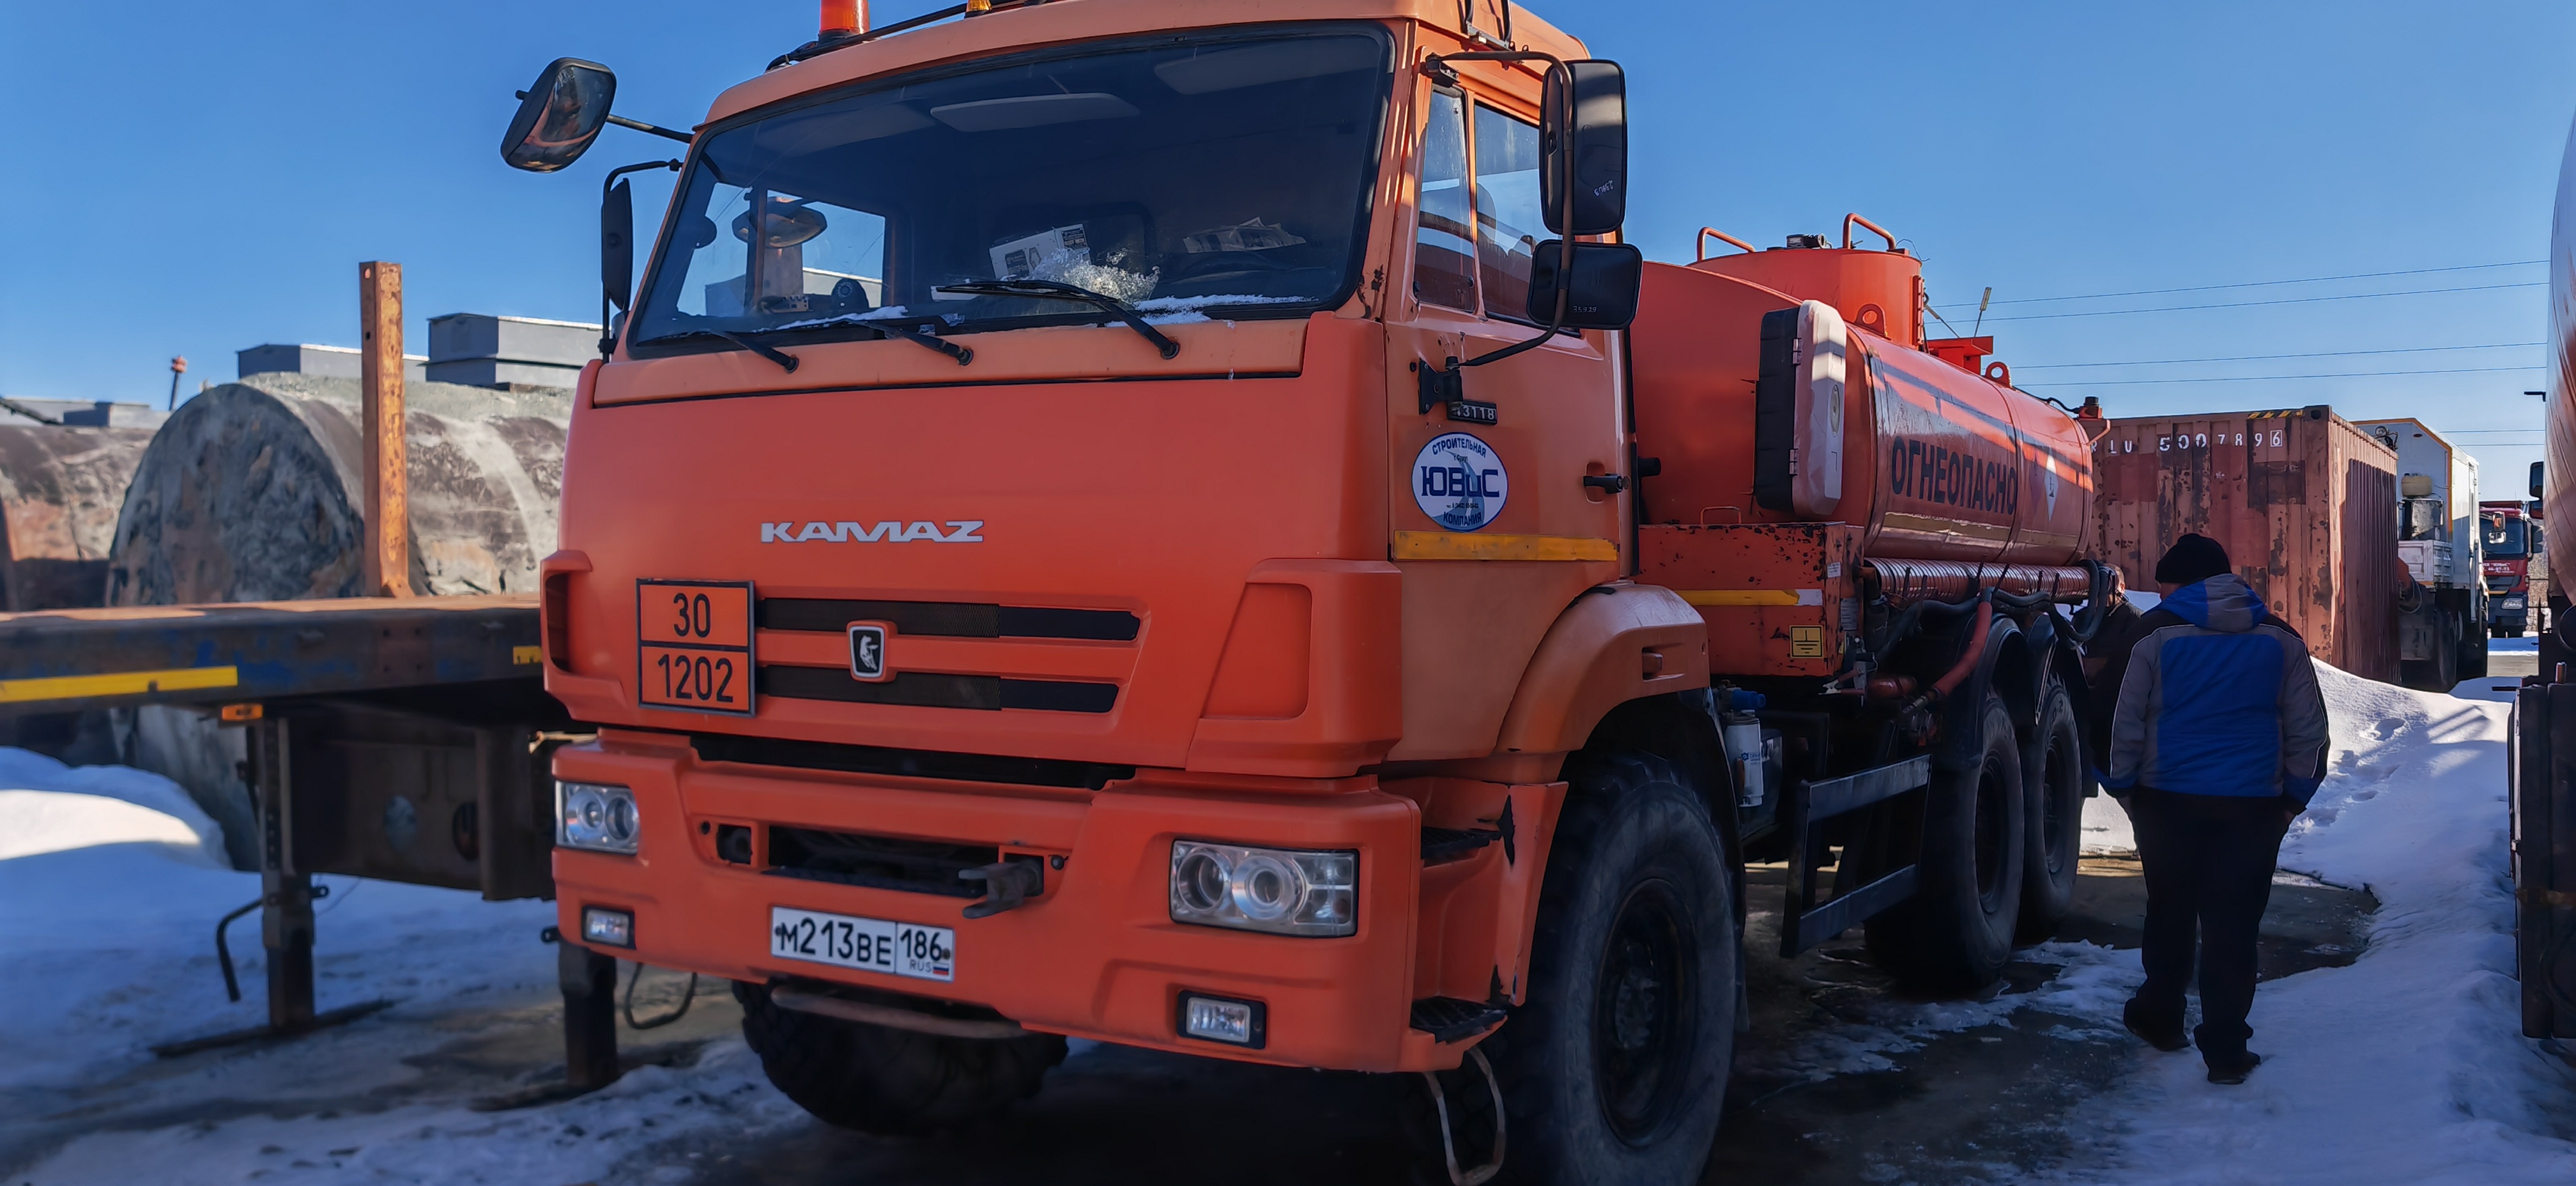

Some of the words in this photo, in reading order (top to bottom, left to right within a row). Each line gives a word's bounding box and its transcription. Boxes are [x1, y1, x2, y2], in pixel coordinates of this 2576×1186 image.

[1432, 437, 1487, 459] СТРОИТЕЛЬНАЯ
[1891, 435, 2017, 515] ОГНЕОПАСНО
[760, 520, 985, 543] KAMAZ
[1443, 511, 1482, 526] КОМПАНИЯ
[673, 592, 711, 638] 30
[657, 654, 733, 703] 1202
[900, 928, 942, 962] 186
[909, 959, 932, 973] RUS
